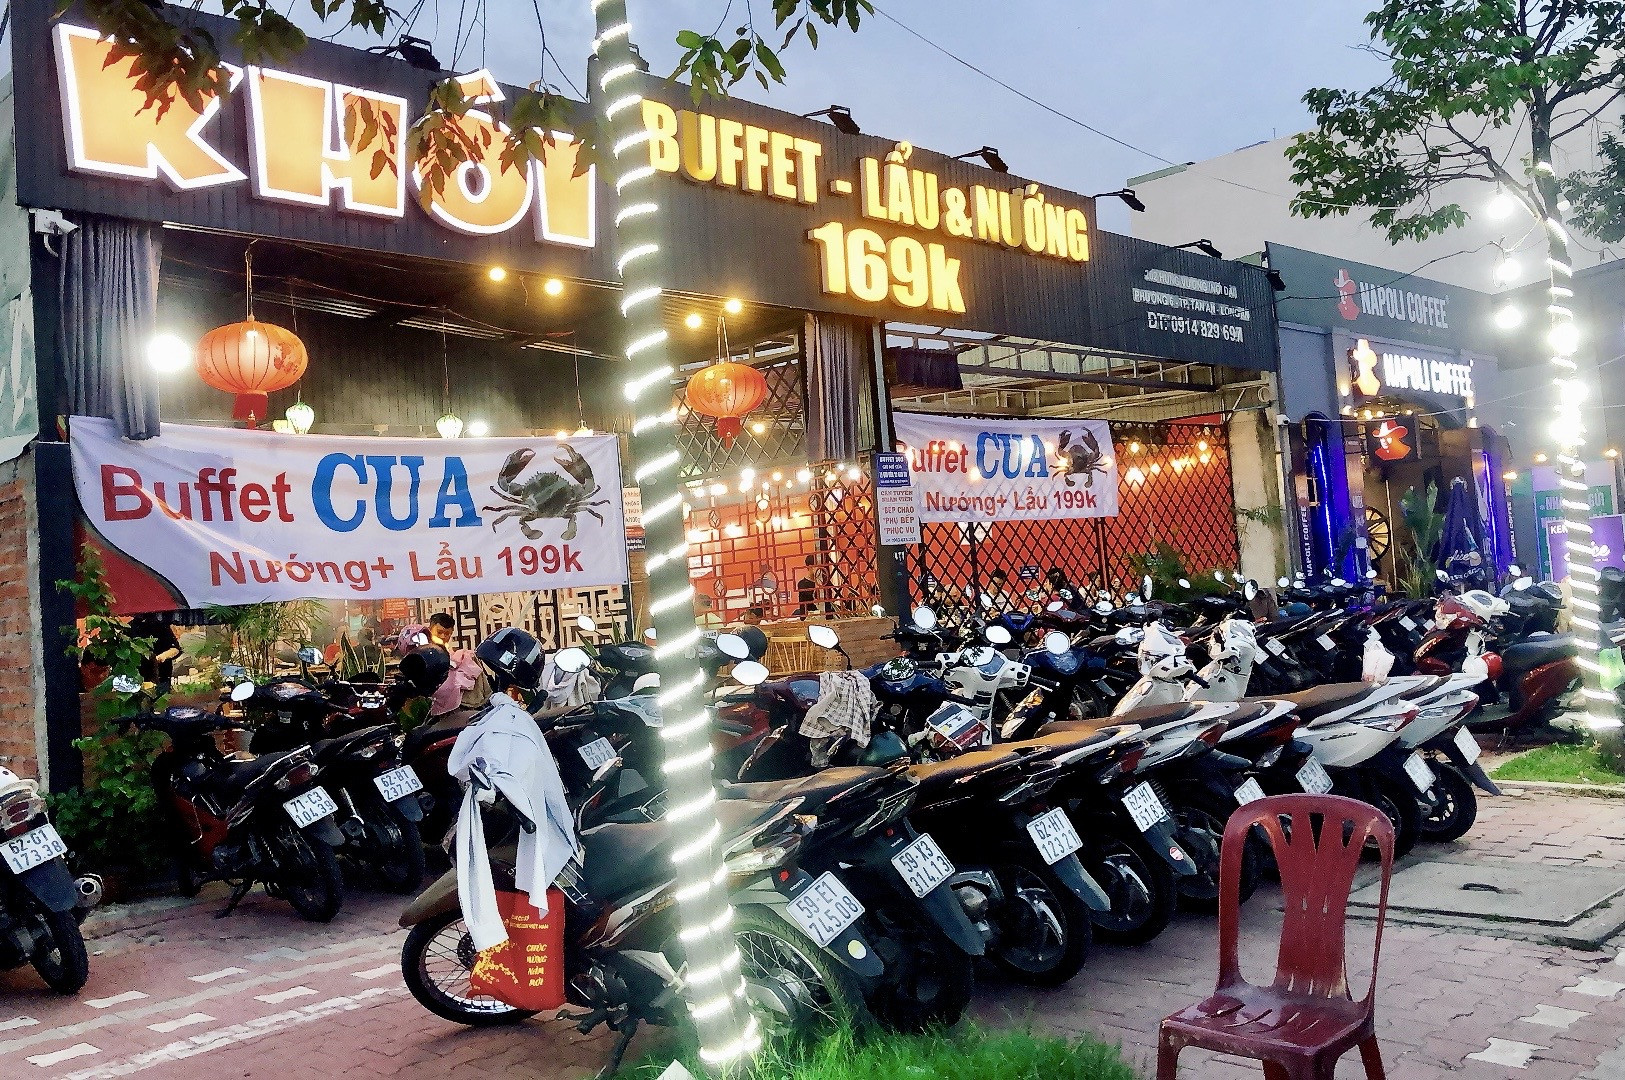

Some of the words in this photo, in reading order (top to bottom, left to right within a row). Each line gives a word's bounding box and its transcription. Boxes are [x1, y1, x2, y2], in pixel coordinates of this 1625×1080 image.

[53, 23, 596, 248] KHÔI
[642, 98, 822, 204] BUFFET
[860, 141, 940, 230] LẨU
[941, 187, 974, 238] &
[970, 183, 1090, 262] NƯỚNG
[1171, 315, 1199, 336] 0914
[1360, 282, 1406, 320] NAPOLI
[1406, 292, 1449, 328] COFFEE
[1383, 353, 1431, 391] NAPOLI
[1430, 360, 1473, 397] COFFEE
[976, 432, 1049, 479] CUA
[100, 464, 295, 523] Buffet
[311, 452, 482, 532] CUA
[1014, 486, 1048, 511] Lẩu
[1053, 490, 1097, 509] 199k
[409, 542, 483, 582] Lẩu
[497, 544, 585, 576] 199k
[12, 840, 63, 870] 173.38
[1042, 829, 1078, 860] 123.21
[909, 855, 950, 894] 314.13
